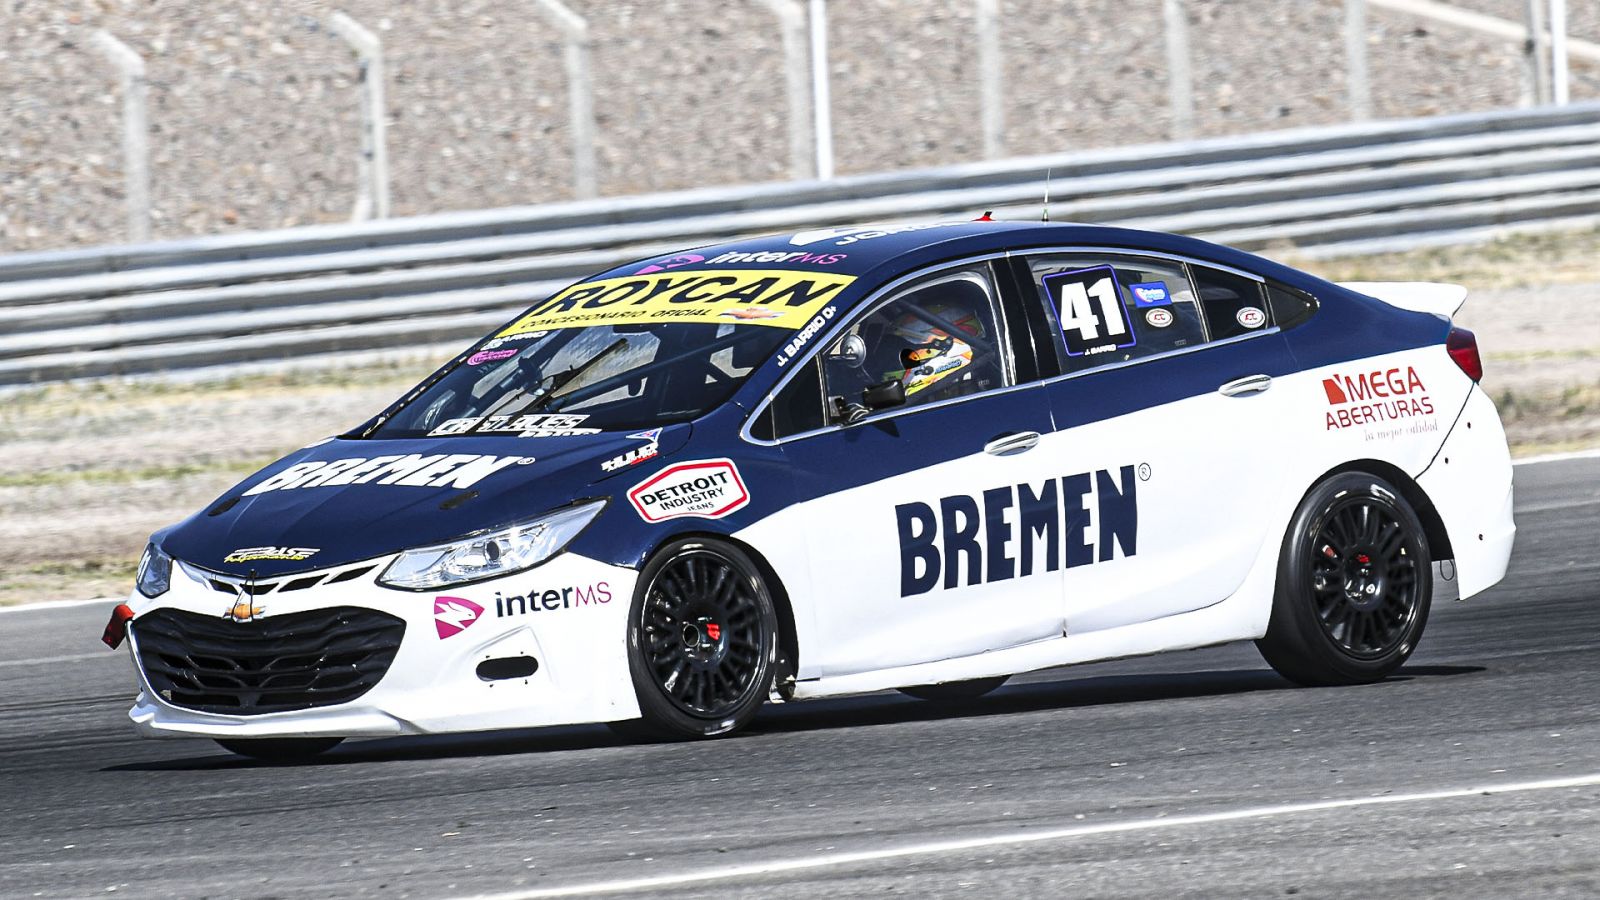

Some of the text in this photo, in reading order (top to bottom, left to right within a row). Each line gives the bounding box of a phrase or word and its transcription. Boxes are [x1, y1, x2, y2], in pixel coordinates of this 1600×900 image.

[706, 251, 847, 264] interMS
[535, 276, 844, 316] ROYCAN
[650, 308, 709, 318] OFICIAL
[1060, 277, 1126, 340] 41
[784, 315, 826, 357] BARRIO
[1344, 366, 1426, 402] MEGA
[1326, 396, 1435, 430] ABERTURAS
[640, 472, 728, 505] DETROIT
[660, 487, 725, 511] INDUSTRY
[687, 502, 715, 511] JEANS
[895, 465, 1138, 598] BREMEN
[495, 581, 612, 618] interMS
